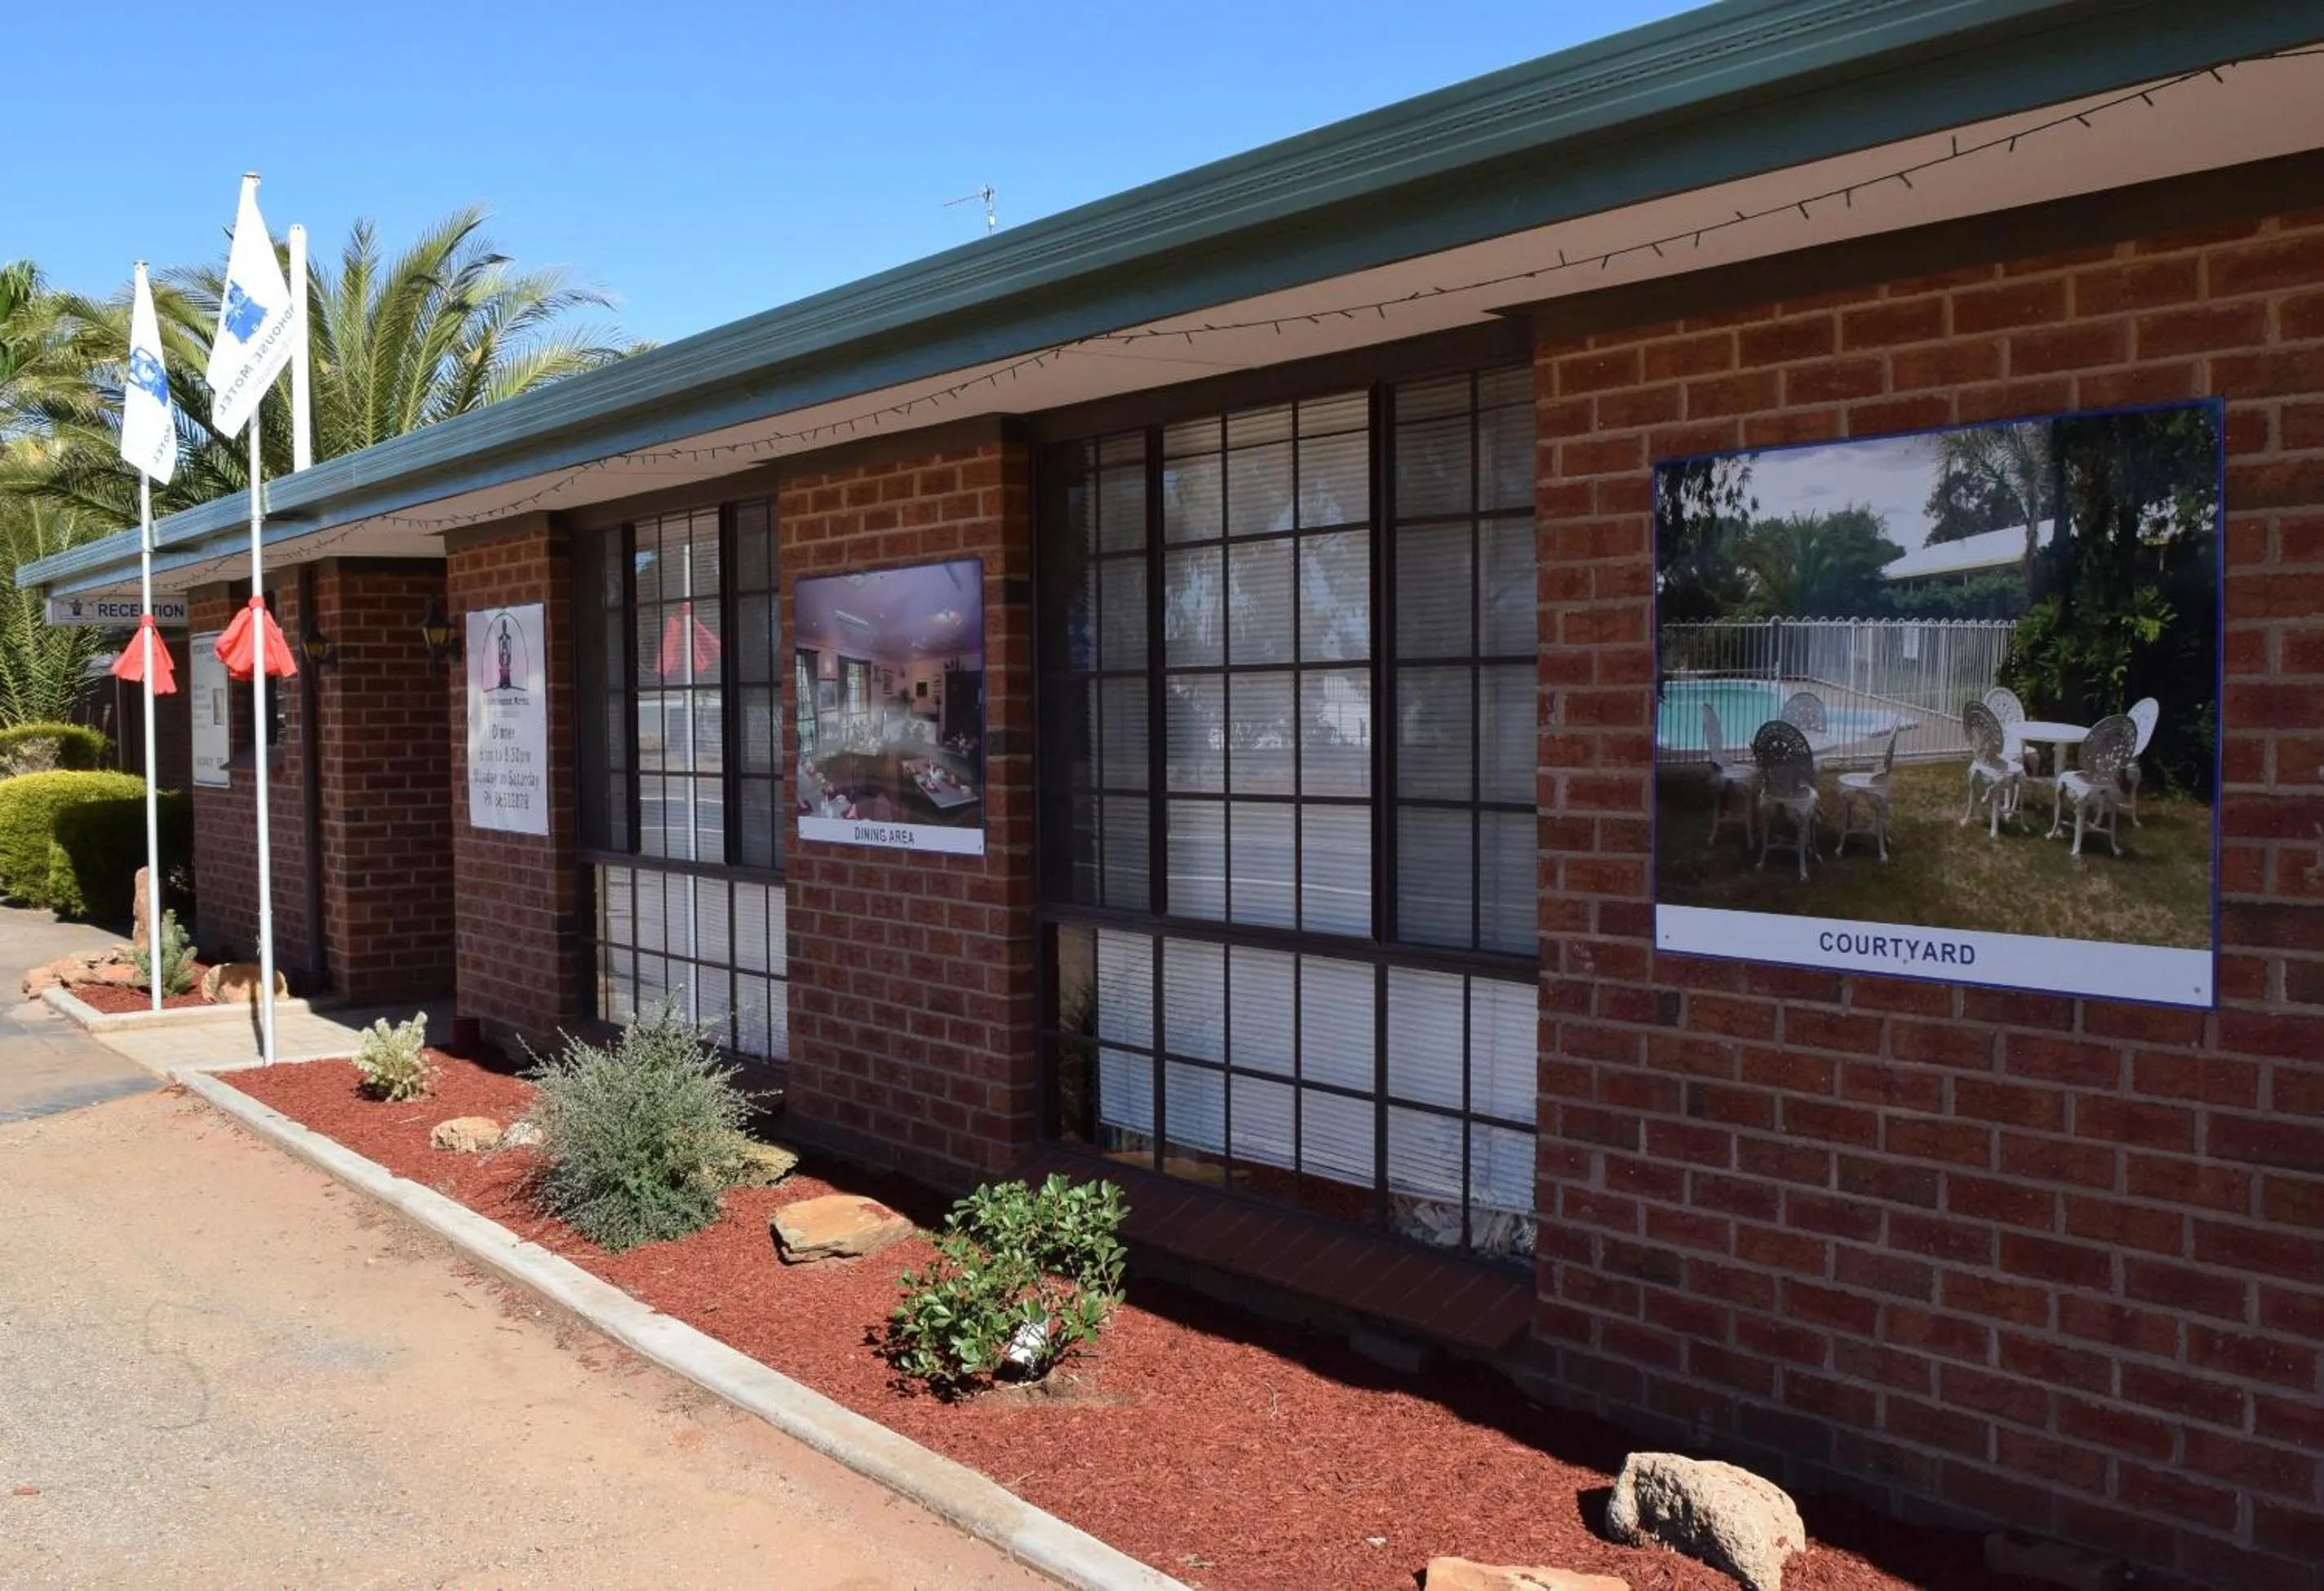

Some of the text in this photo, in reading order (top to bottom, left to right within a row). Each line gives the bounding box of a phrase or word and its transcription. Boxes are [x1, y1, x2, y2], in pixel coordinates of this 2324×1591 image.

[98, 604, 184, 618] RECETION
[854, 827, 915, 844] DINING AREA
[1820, 932, 1975, 964] COURTYARD
